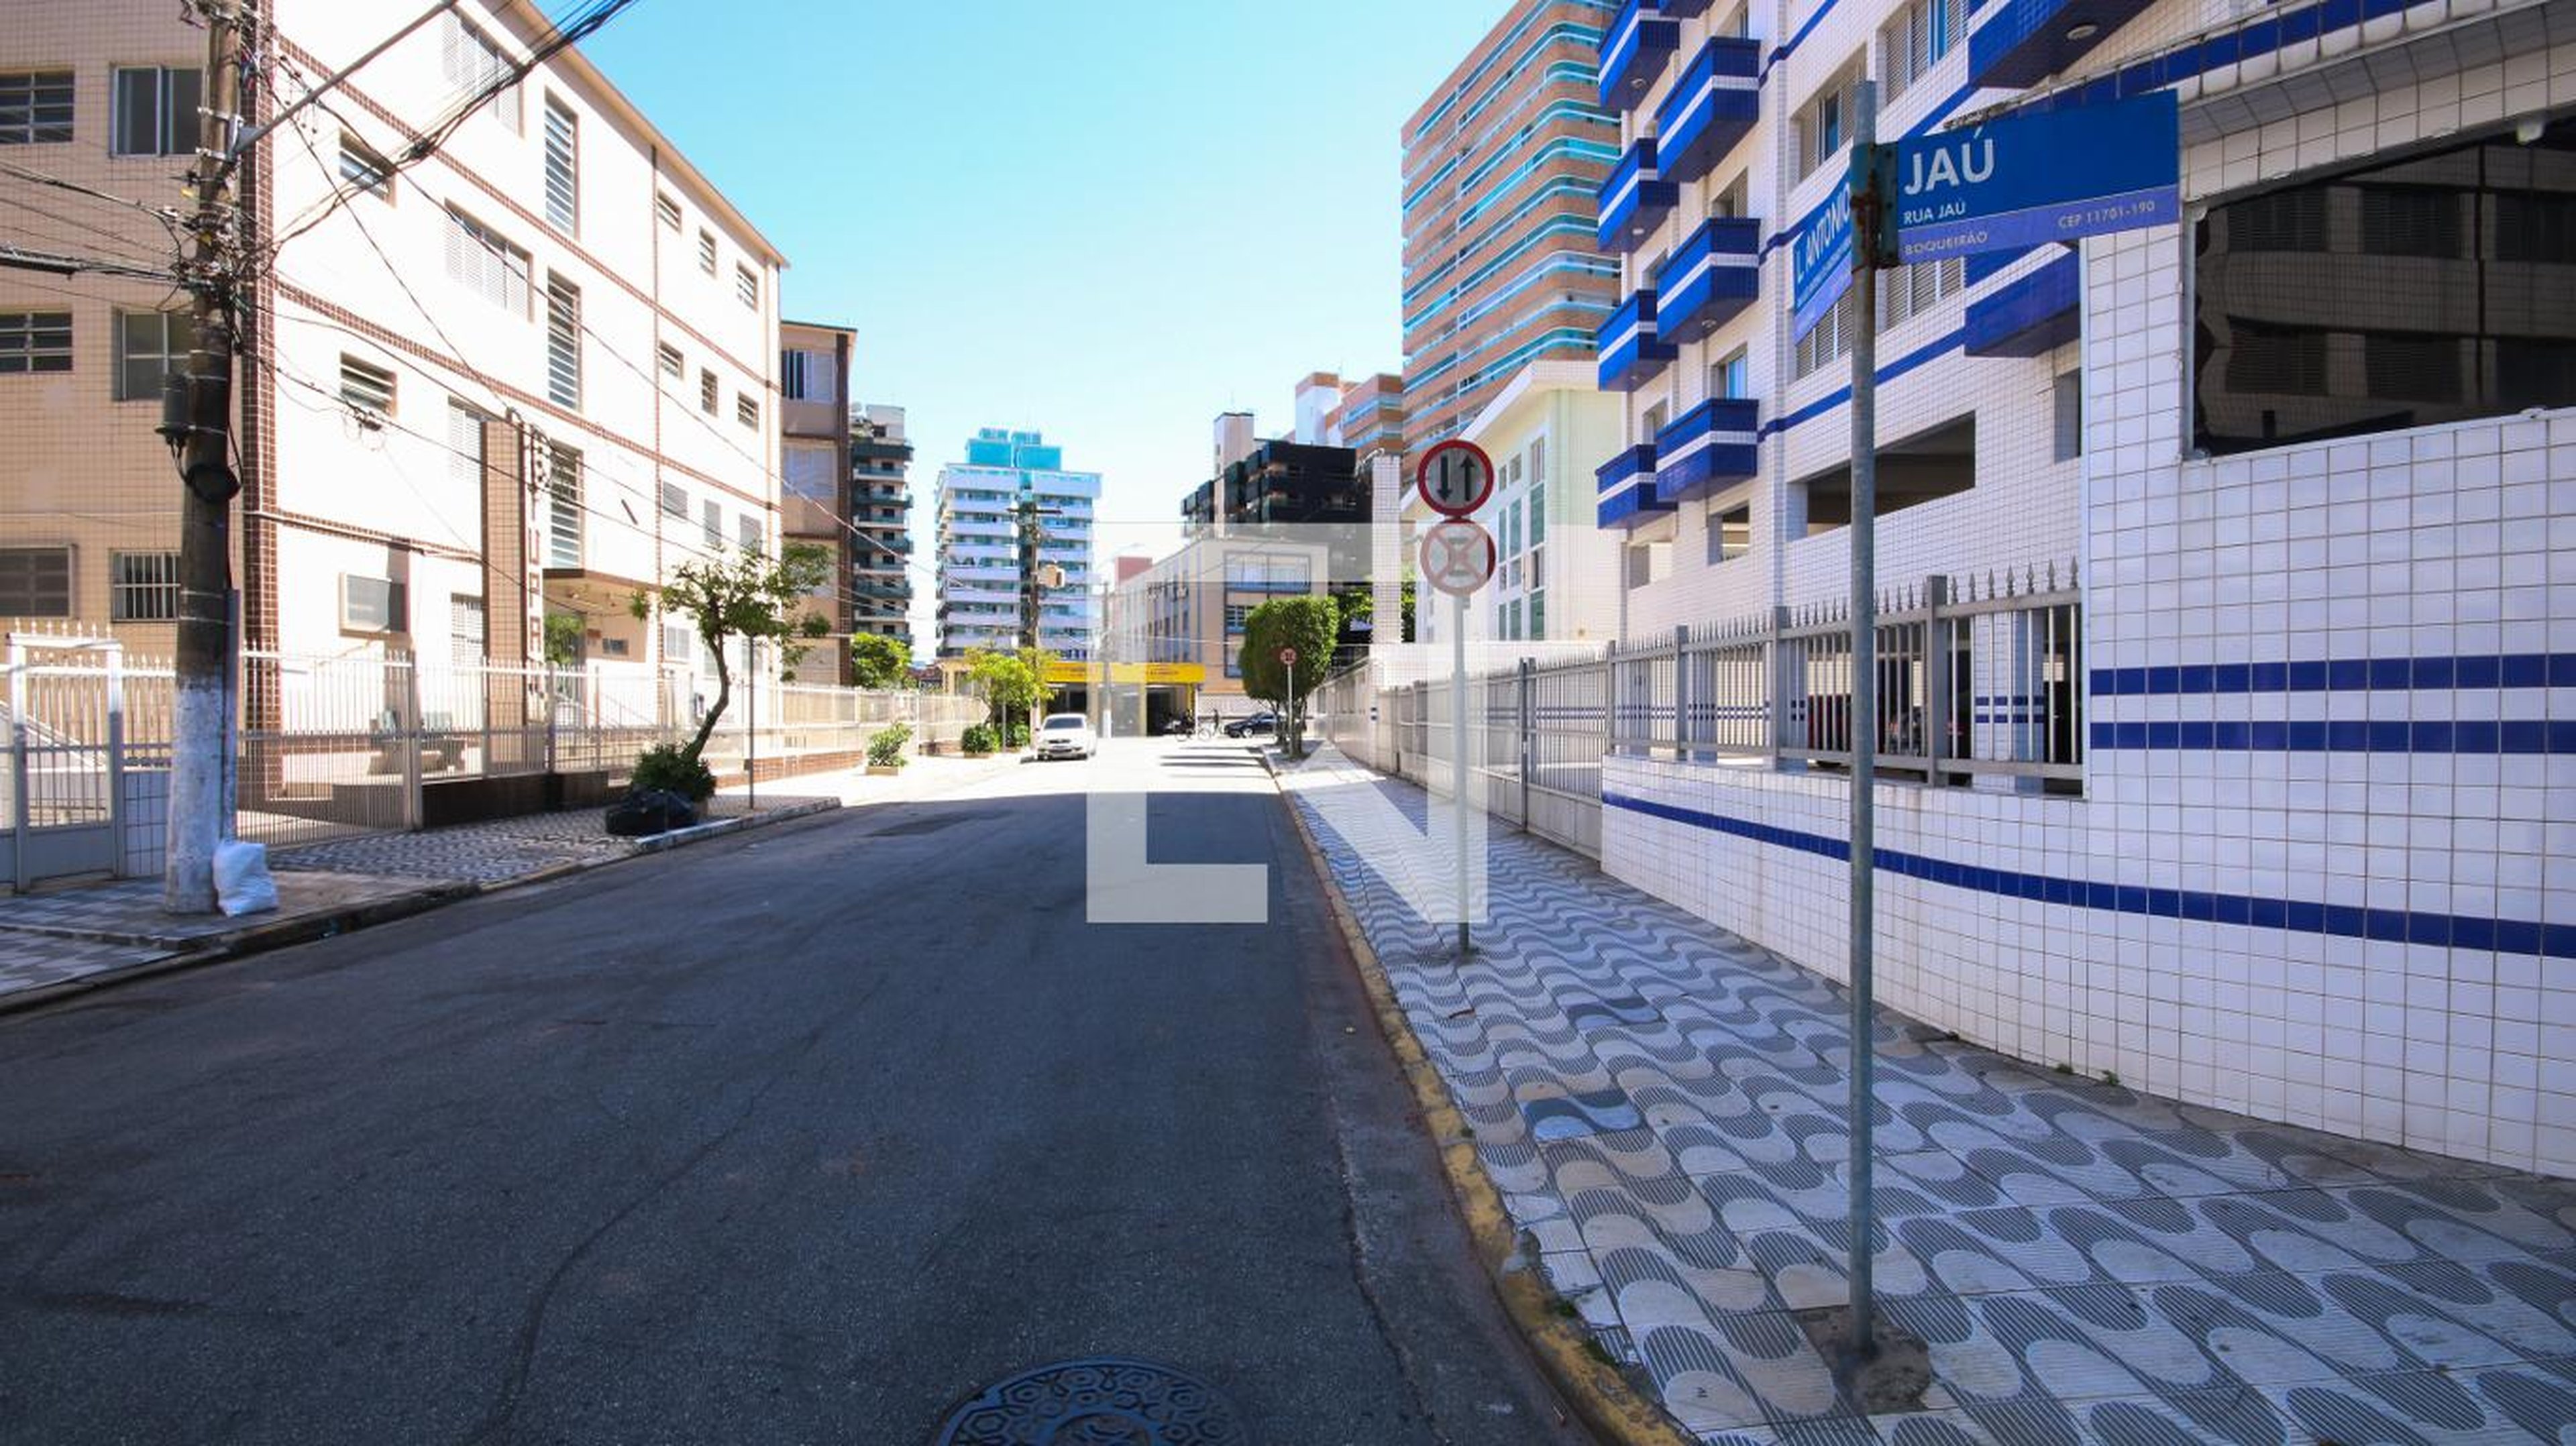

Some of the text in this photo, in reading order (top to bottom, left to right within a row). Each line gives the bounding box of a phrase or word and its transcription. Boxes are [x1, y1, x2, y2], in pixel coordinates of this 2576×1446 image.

[1904, 125, 1995, 195] JAÚ
[1903, 198, 1966, 225] RUA JAÚ
[2057, 201, 2155, 229] CEP 11701-190
[1904, 230, 1988, 256] BOQUEIRÃO
